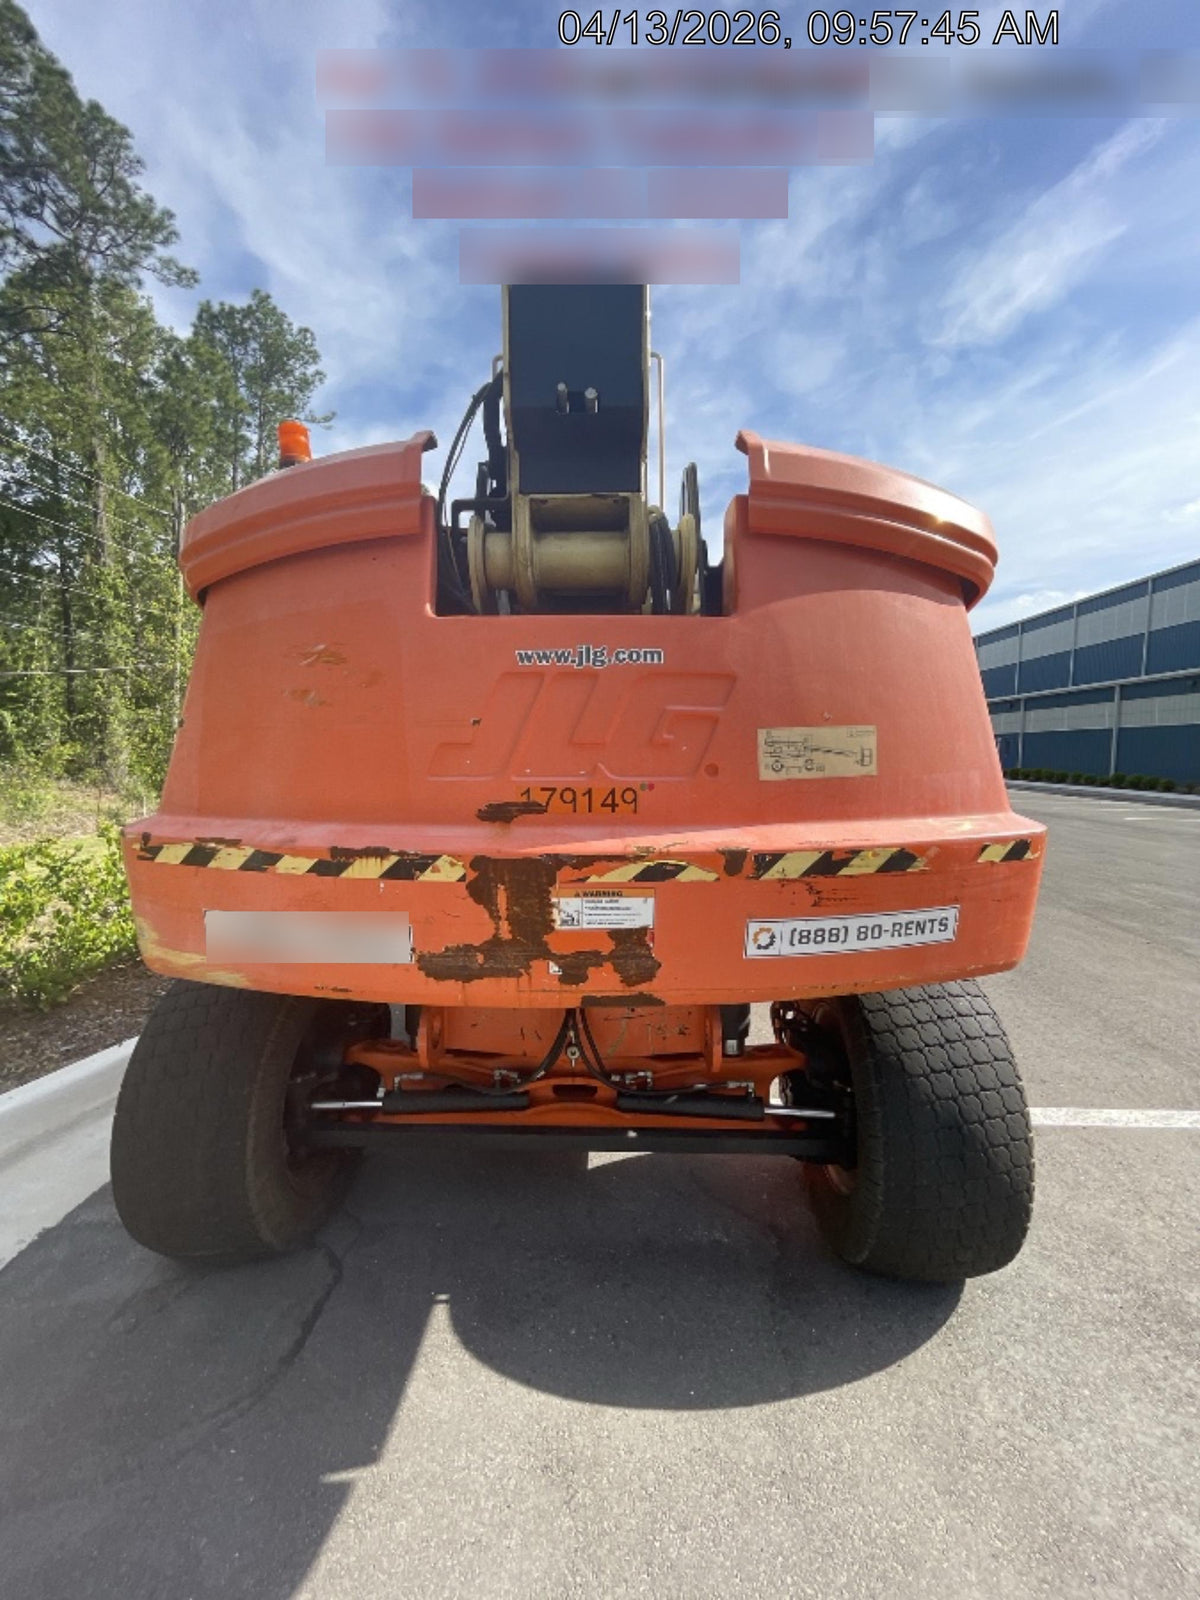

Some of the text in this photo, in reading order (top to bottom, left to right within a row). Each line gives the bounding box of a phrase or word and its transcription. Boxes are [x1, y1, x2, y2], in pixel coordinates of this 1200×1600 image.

[515, 645, 664, 668] www.jlg.com
[427, 672, 737, 781] JLG
[789, 916, 949, 947] (888) 80-RENTS
